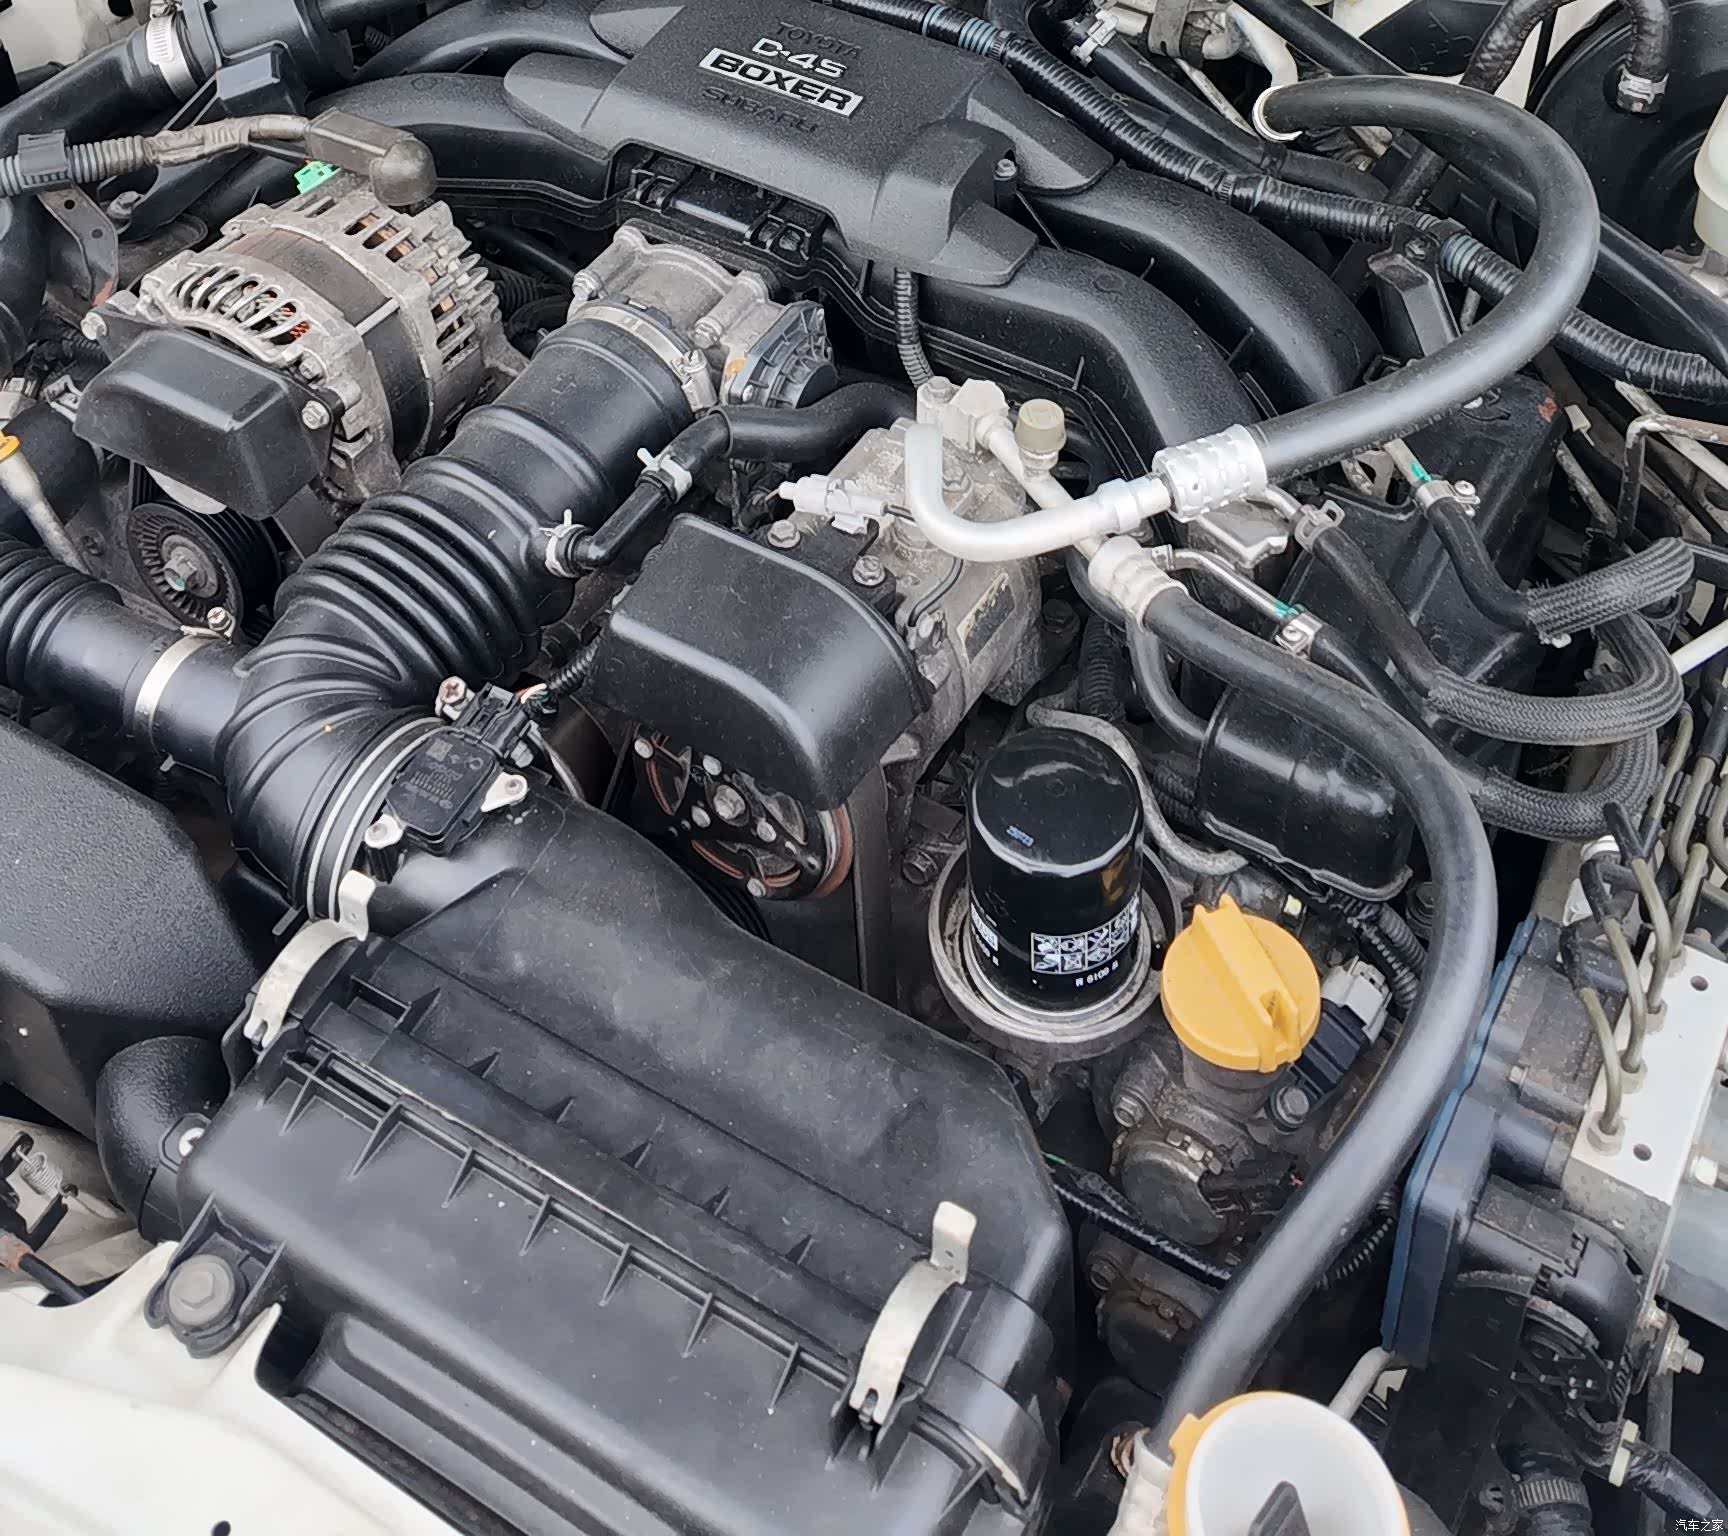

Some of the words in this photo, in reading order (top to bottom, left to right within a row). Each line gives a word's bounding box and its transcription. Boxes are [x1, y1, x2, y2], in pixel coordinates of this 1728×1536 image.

[751, 37, 849, 79] D-4S
[775, 21, 862, 59] TOYOTA
[709, 53, 853, 110] BOXER
[701, 85, 820, 134] SUBARU
